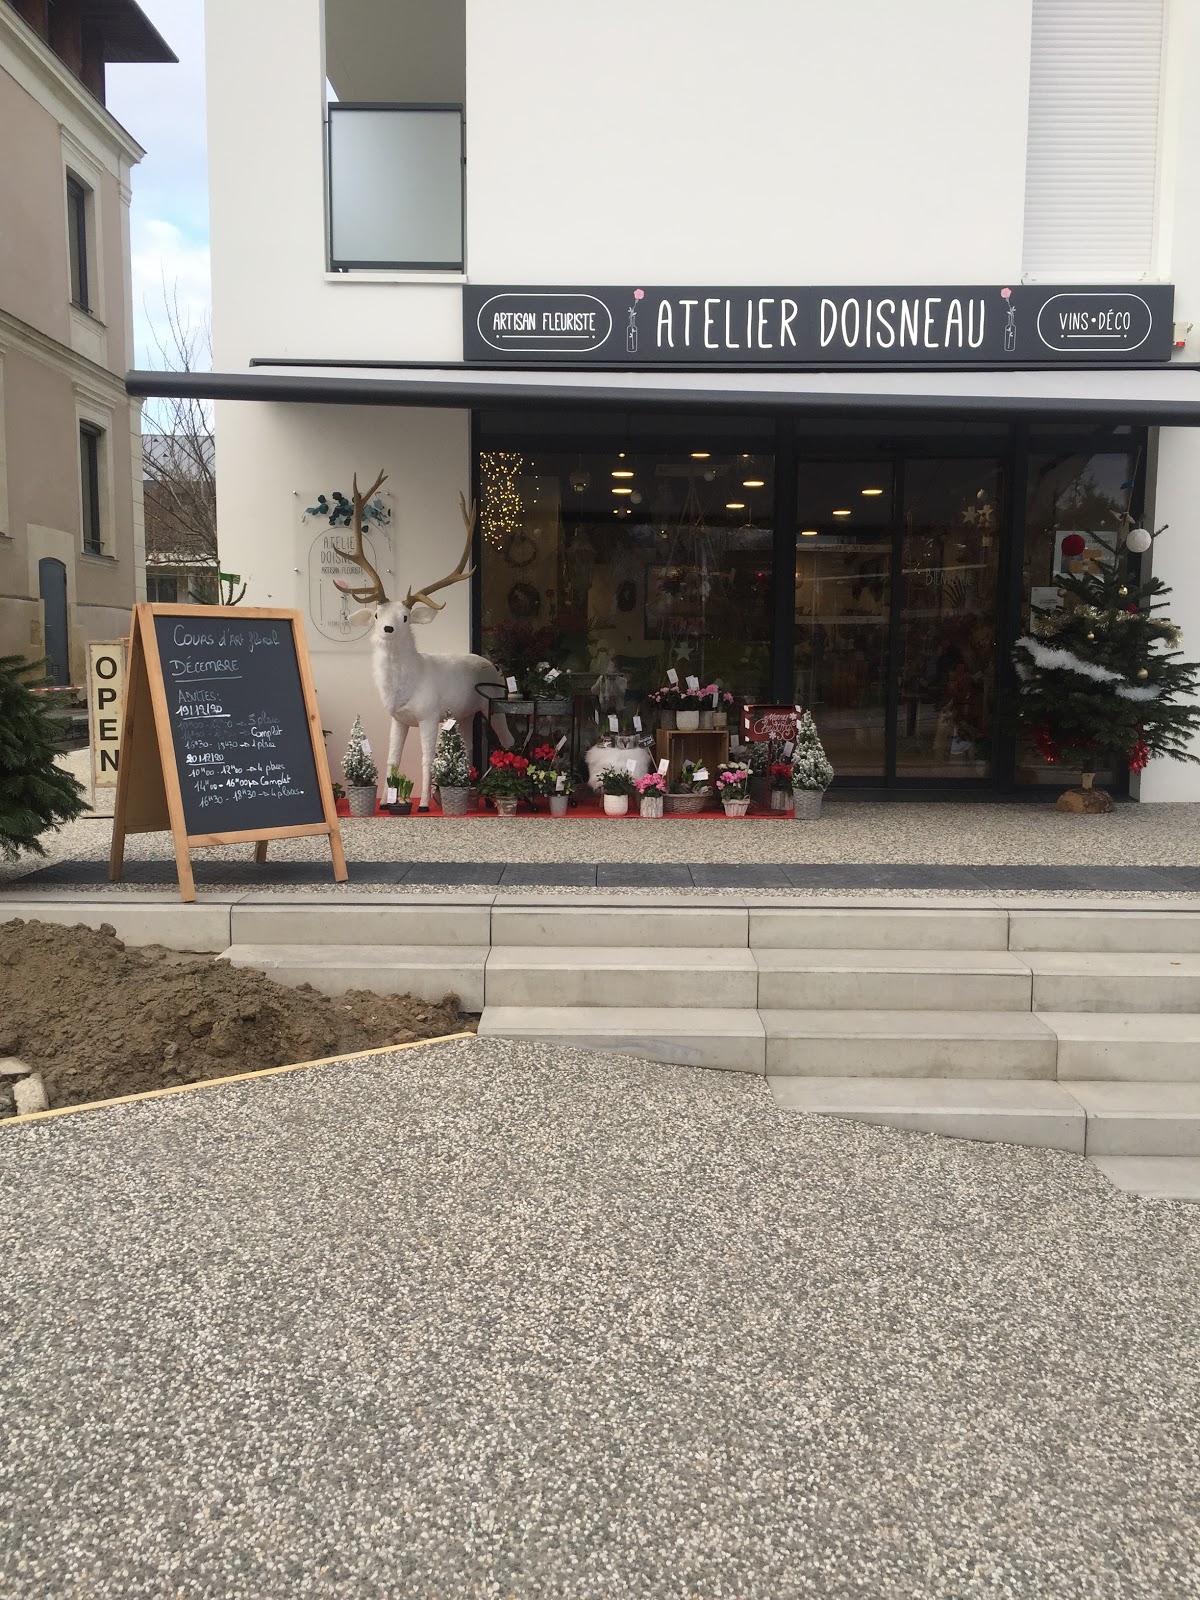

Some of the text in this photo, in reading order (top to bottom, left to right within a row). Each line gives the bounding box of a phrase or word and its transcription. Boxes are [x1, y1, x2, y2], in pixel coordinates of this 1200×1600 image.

[492, 312, 596, 331] ARTISAN FLEURISTE
[657, 298, 986, 349] ATELIER DOISNEAU
[323, 536, 356, 550] ATELIE
[169, 656, 239, 676] DÉCEMBRE
[95, 656, 119, 772] OPEN
